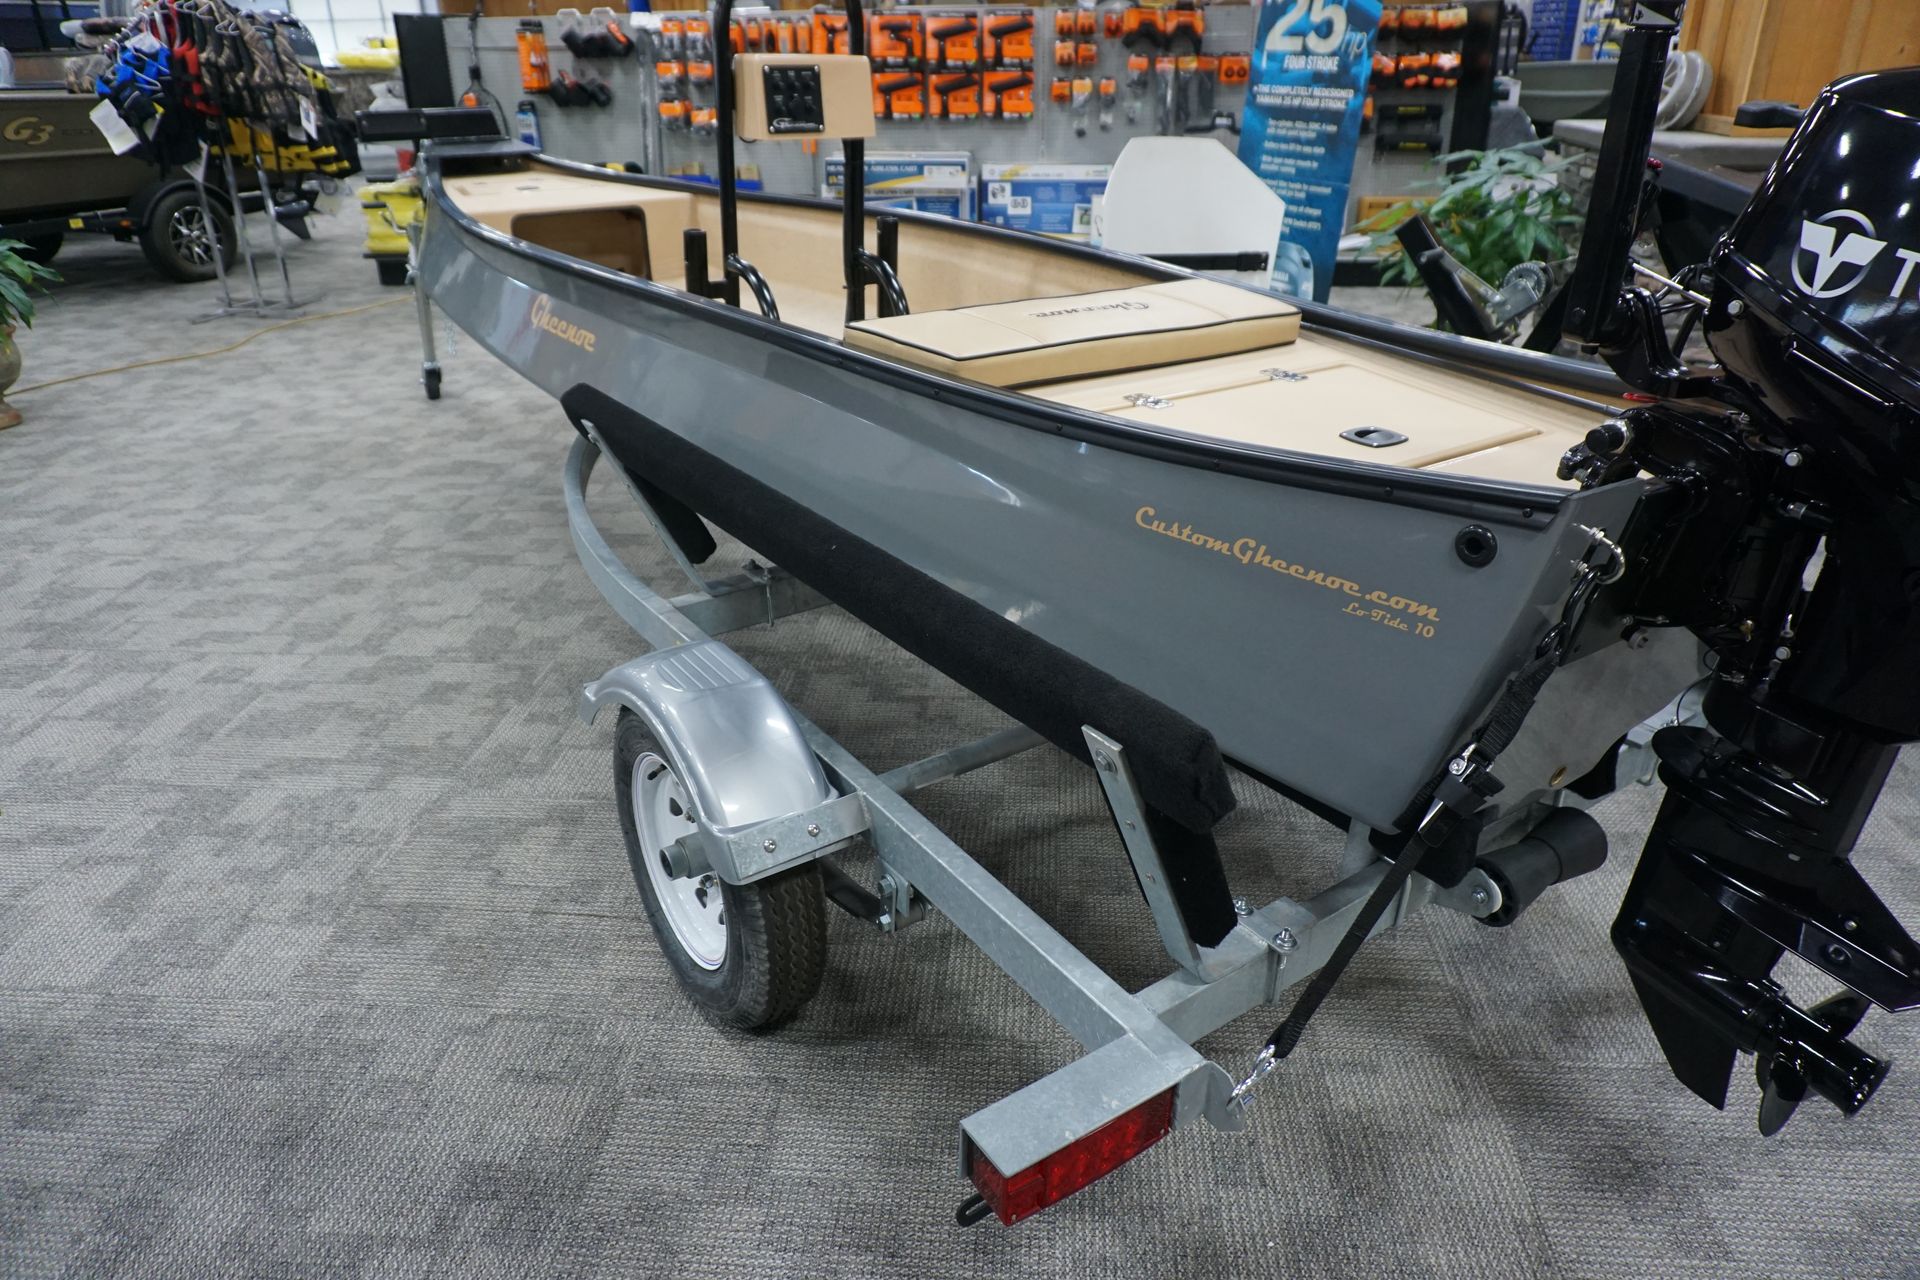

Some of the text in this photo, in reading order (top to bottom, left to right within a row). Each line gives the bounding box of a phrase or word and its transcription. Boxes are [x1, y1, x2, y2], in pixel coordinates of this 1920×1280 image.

[1265, 0, 1347, 54] 25
[1283, 55, 1340, 71] FOUR STROKE
[1271, 85, 1312, 96] COMPLETELY
[1313, 87, 1354, 98] REDESIGNED
[3, 116, 55, 145] G3
[531, 293, 597, 352] Gheenoe
[1415, 622, 1436, 638] 10
